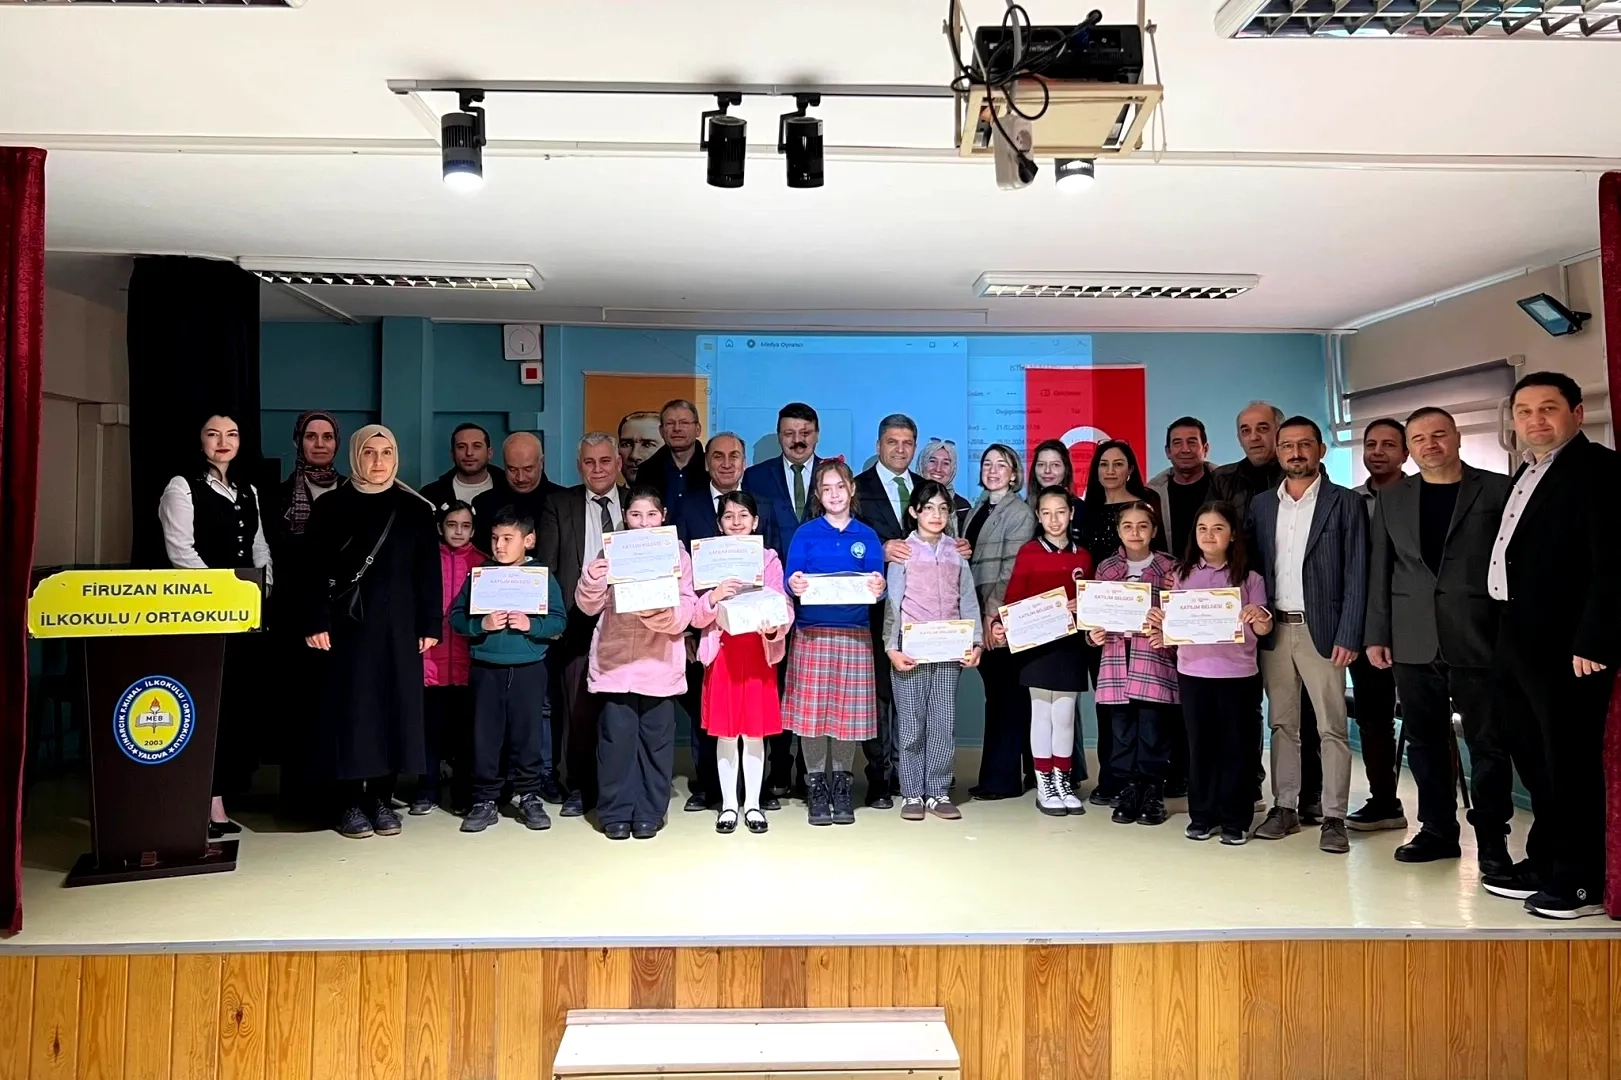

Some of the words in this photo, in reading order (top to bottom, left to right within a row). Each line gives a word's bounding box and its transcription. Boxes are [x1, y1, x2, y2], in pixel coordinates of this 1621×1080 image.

[82, 582, 157, 597] FİRUZAN
[163, 583, 213, 596] KINAL
[41, 612, 130, 626] İLKOKULU
[134, 612, 142, 624] /
[137, 751, 168, 760] YALOVA
